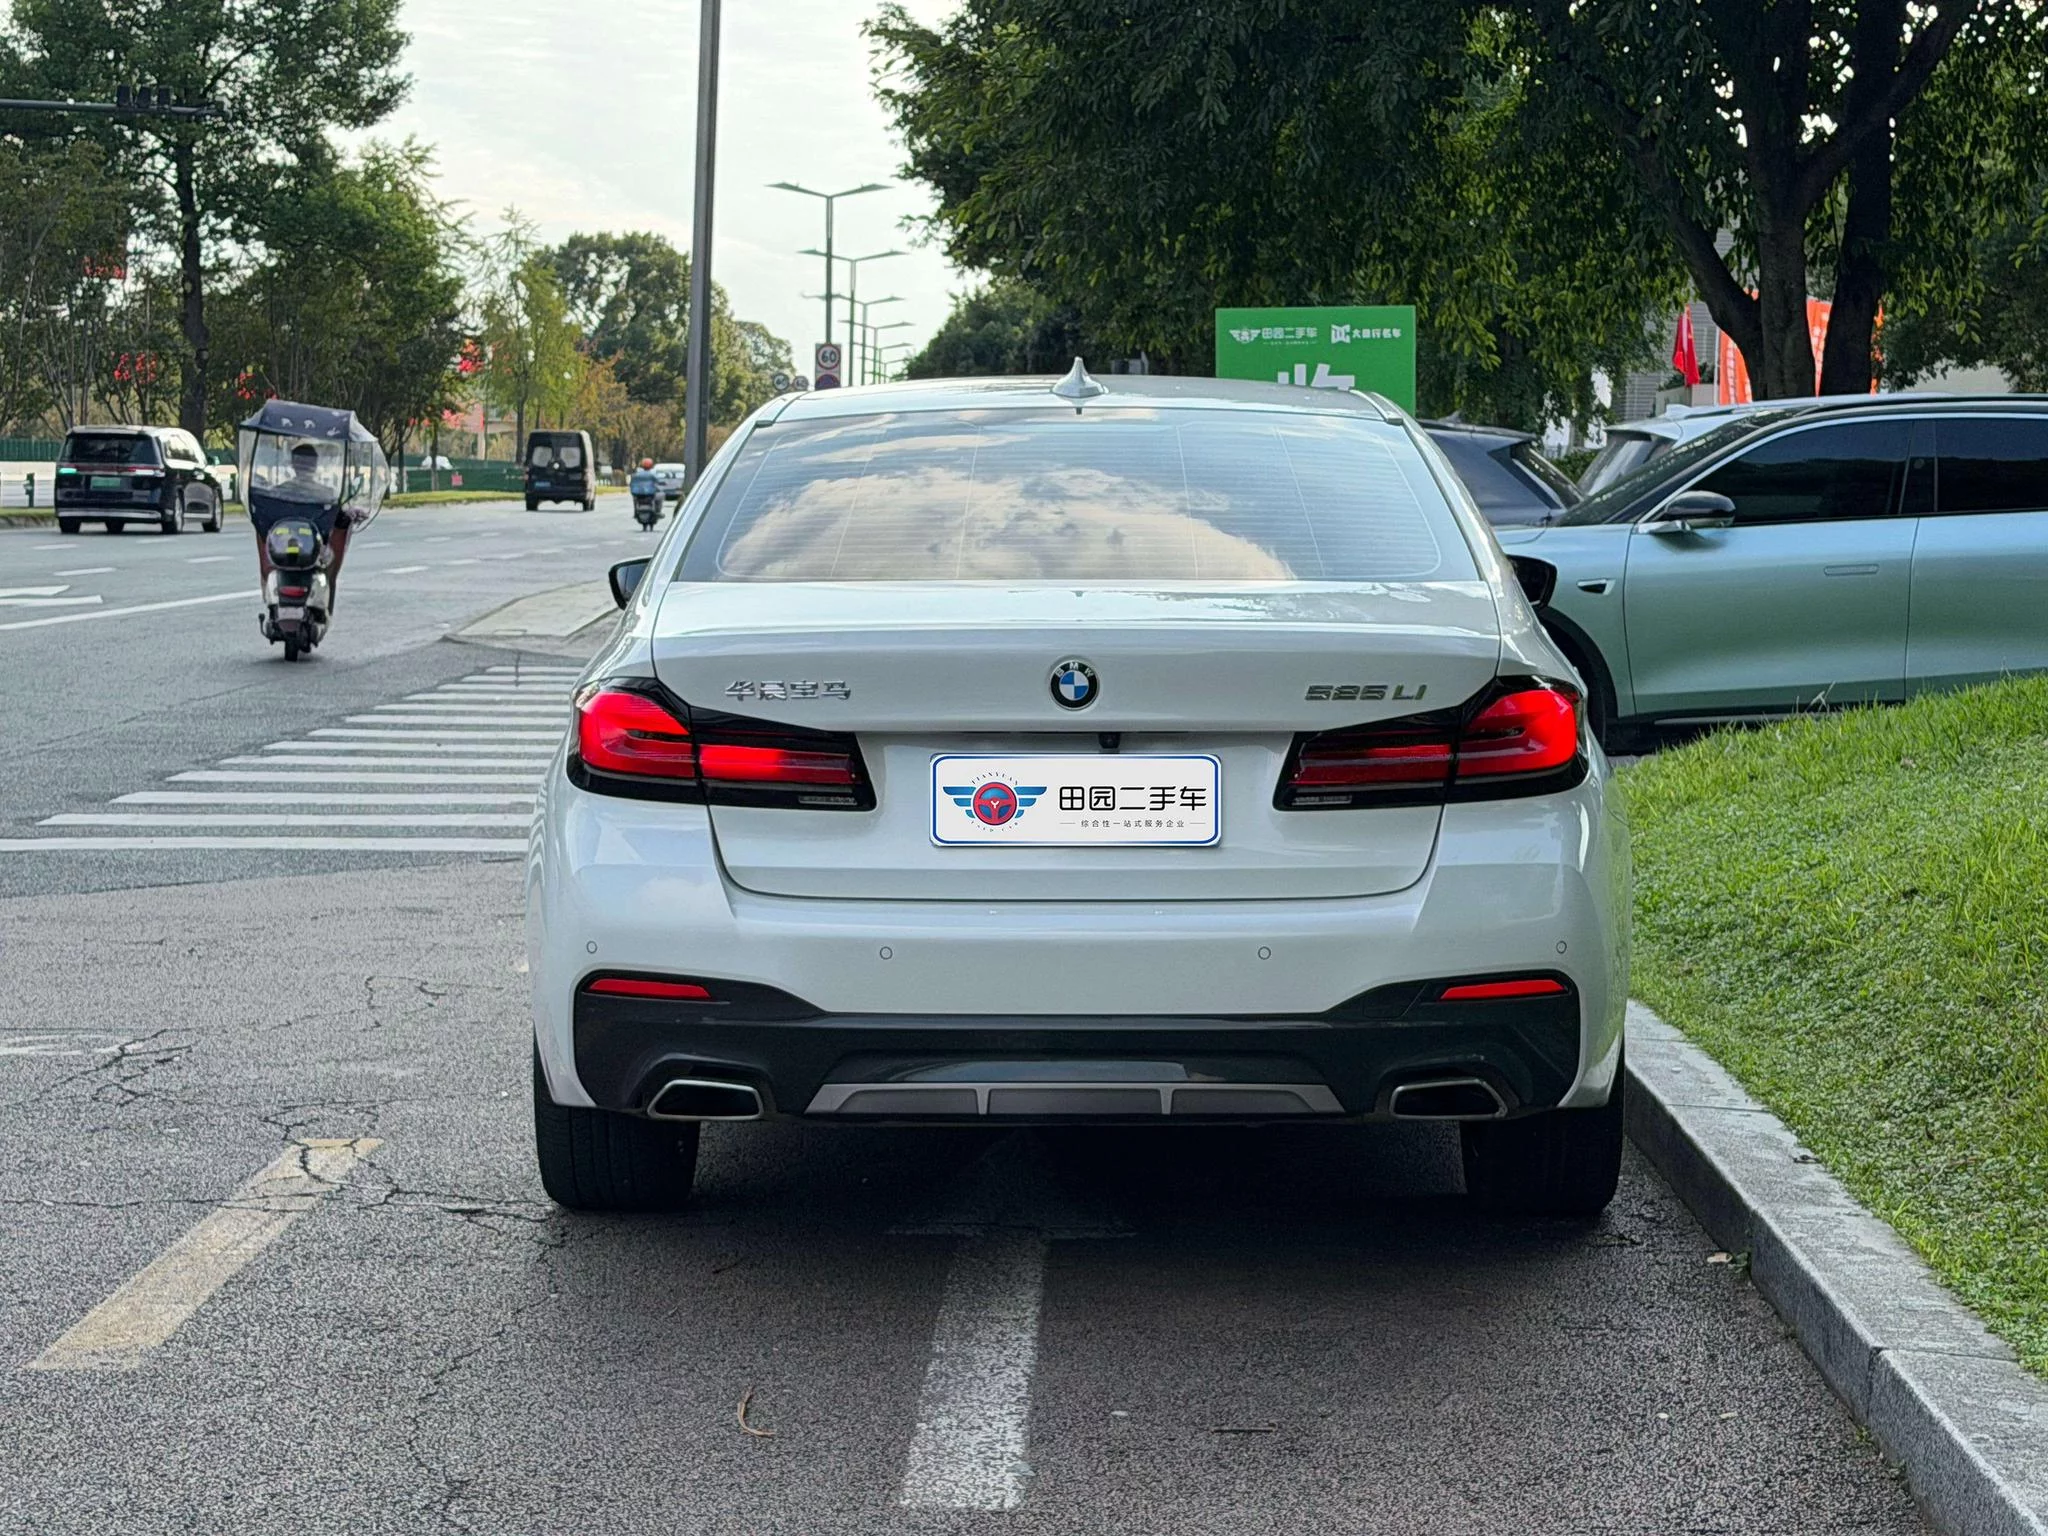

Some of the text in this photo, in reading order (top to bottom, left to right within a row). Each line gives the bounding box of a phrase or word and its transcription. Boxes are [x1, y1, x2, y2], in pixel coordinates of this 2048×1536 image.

[1054, 661, 1095, 678] BMW
[724, 680, 851, 701] 华晨宝马
[1059, 786, 1207, 811] 田园二手车
[1081, 819, 1185, 828] 综合性一站式服务企业
